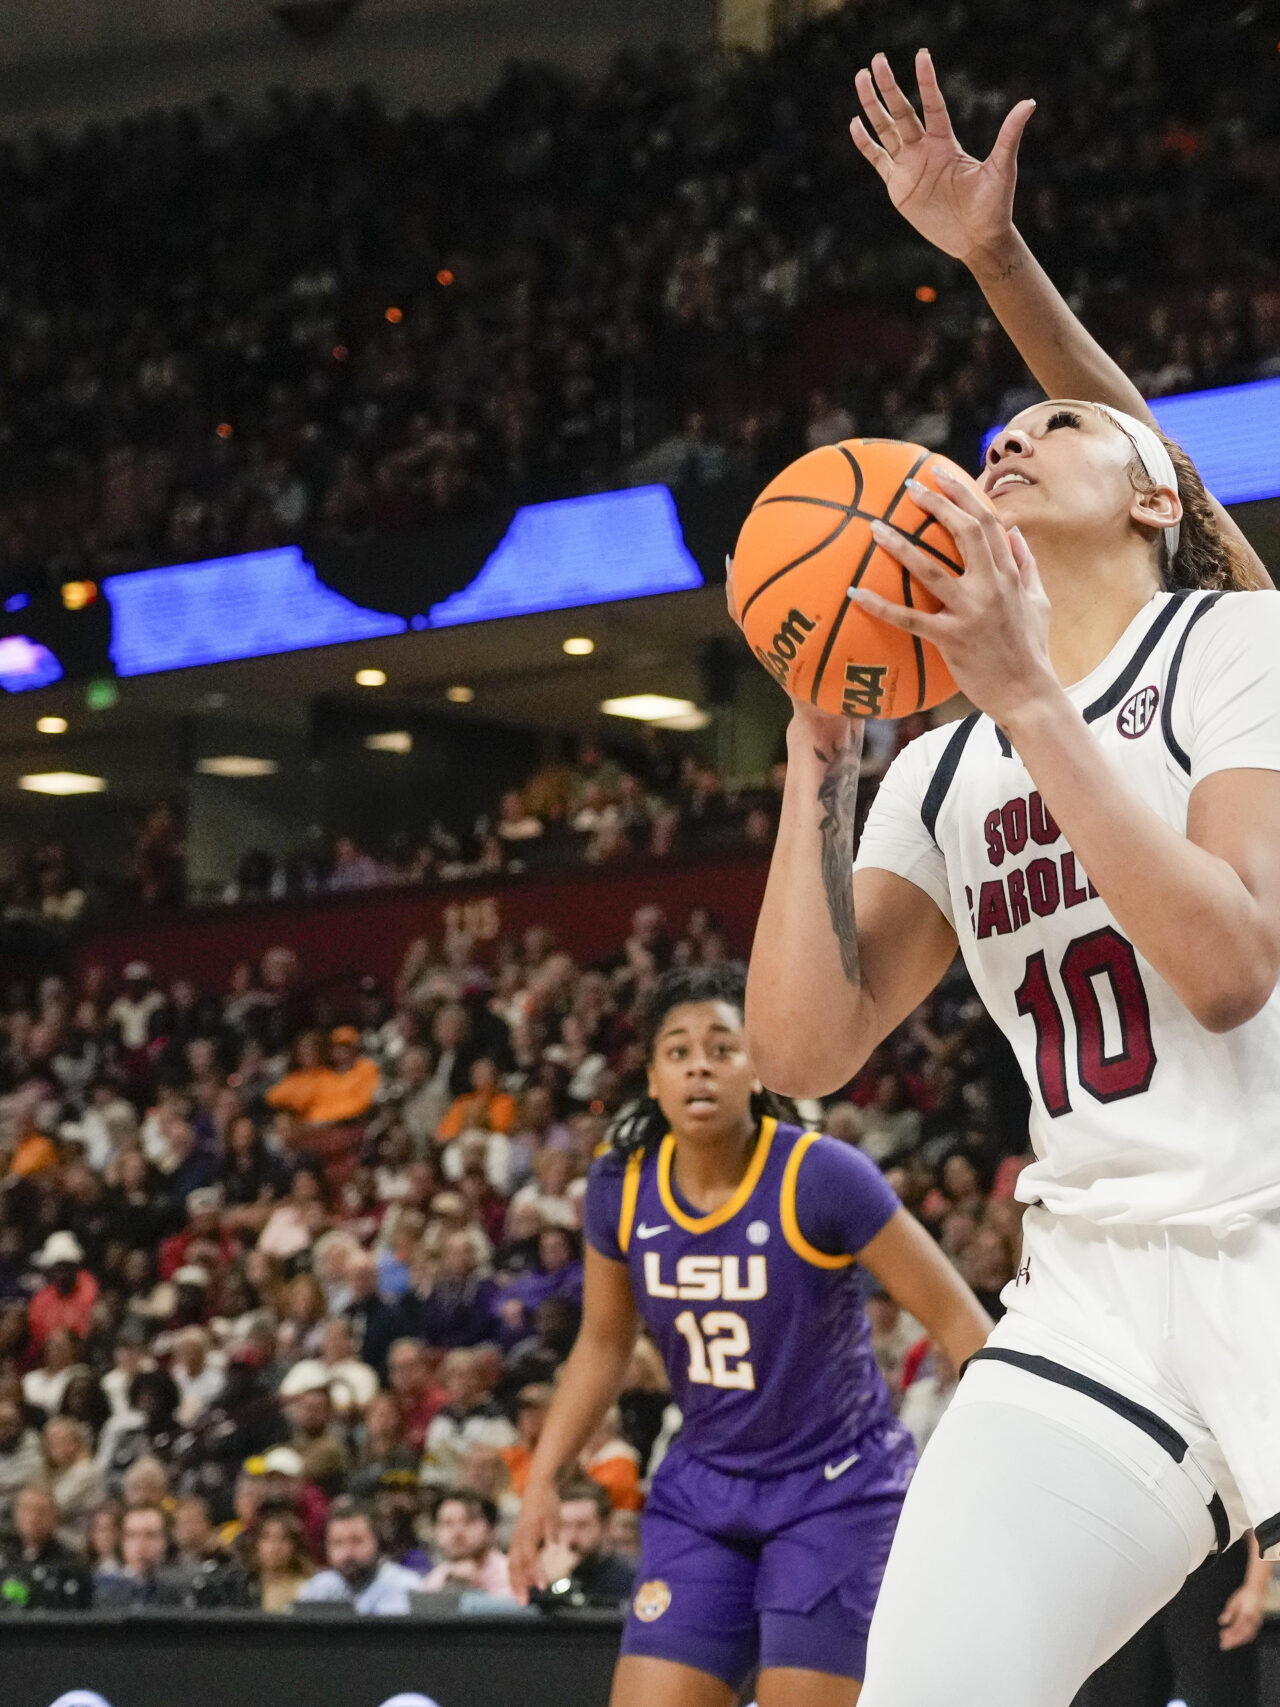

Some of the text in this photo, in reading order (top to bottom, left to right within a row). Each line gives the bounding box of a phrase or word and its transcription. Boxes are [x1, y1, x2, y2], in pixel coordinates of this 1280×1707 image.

[755, 608, 816, 688] lson
[842, 663, 888, 719] CAA
[1118, 687, 1158, 738] SEC
[984, 790, 1062, 868] SOU
[1014, 924, 1158, 1119] 10
[643, 1251, 768, 1301] LSU
[674, 1310, 757, 1390] 12
